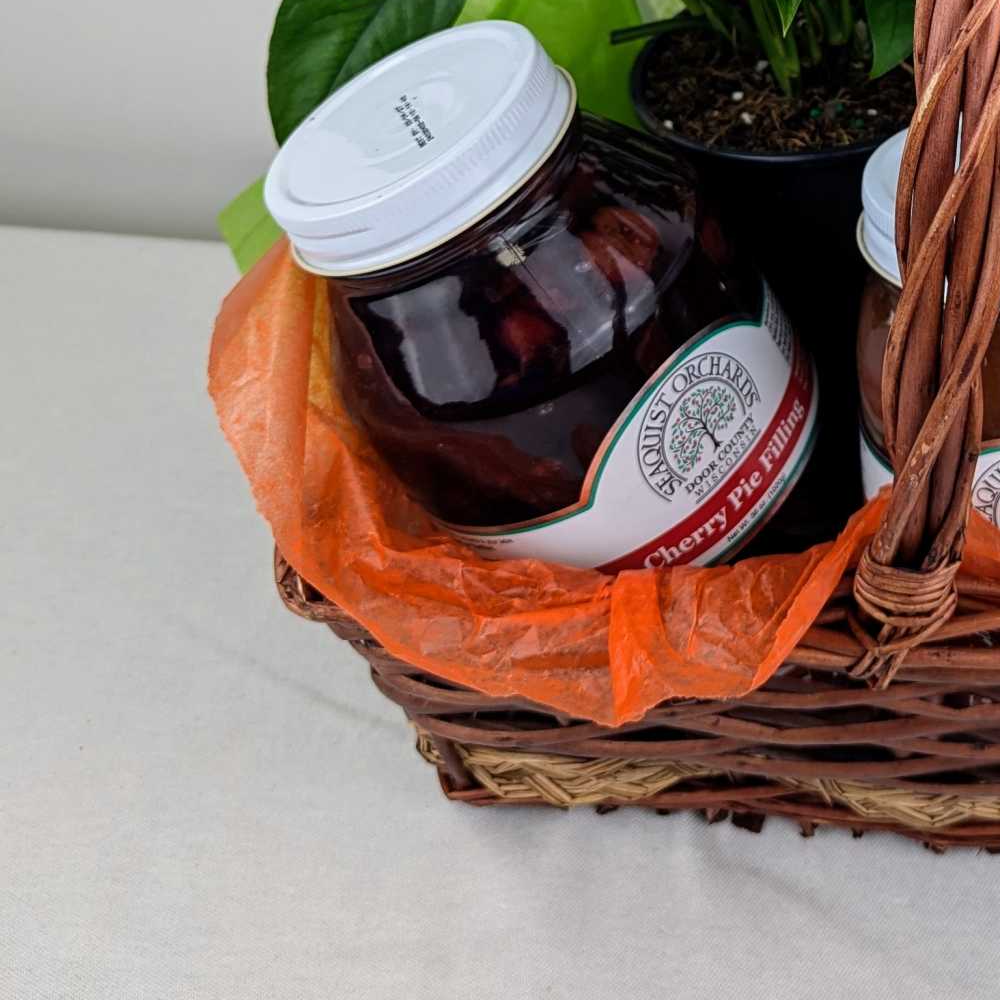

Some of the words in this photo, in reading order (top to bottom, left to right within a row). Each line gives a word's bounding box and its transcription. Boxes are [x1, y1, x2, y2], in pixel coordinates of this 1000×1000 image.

[641, 392, 684, 497] SEAQUIST
[672, 356, 759, 407] ORCHARDS
[684, 460, 717, 494] DOOR
[718, 415, 755, 461] COUNTY
[694, 426, 761, 497] WISCONSIN
[644, 506, 728, 568] Cherry
[727, 471, 762, 510] Pie
[759, 399, 805, 472] Filling
